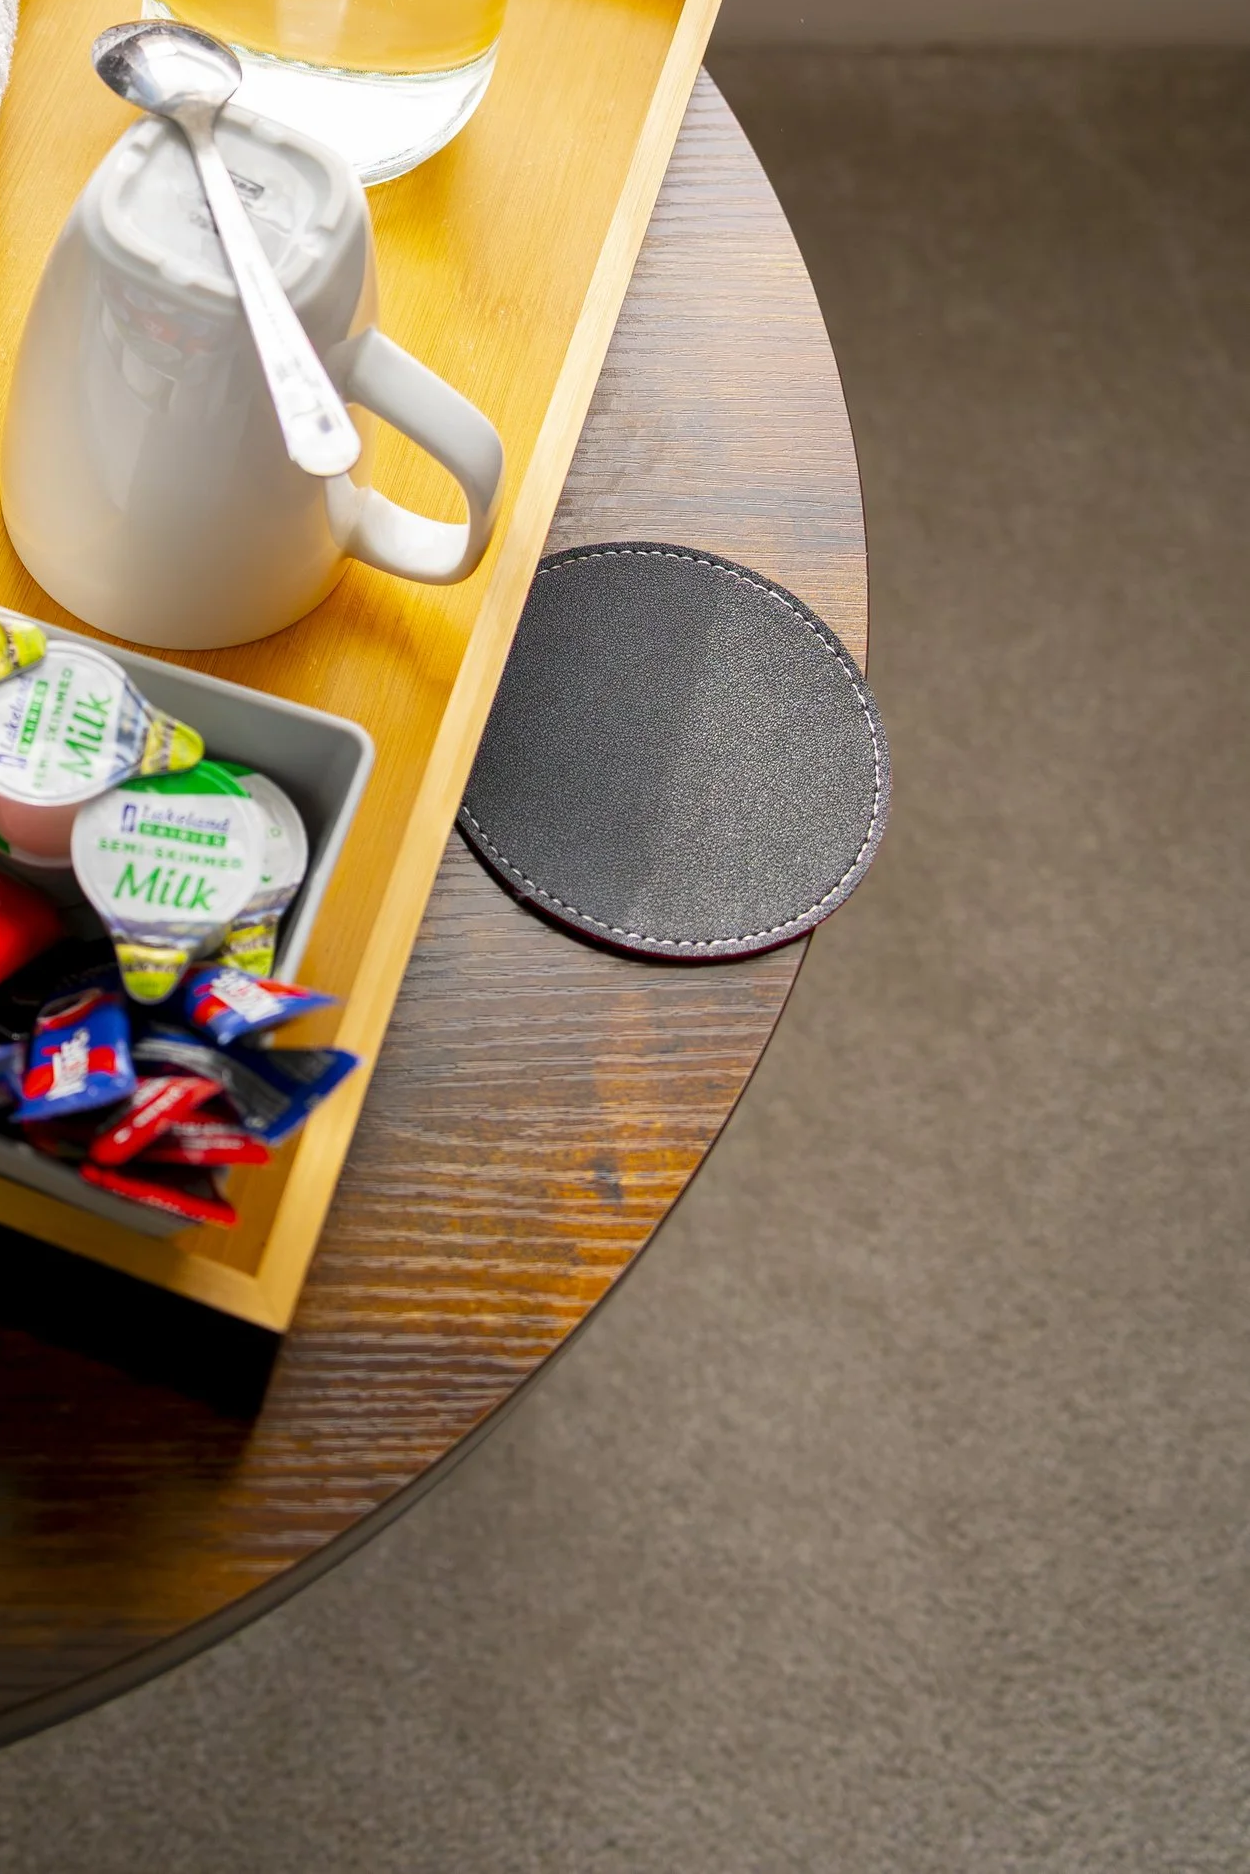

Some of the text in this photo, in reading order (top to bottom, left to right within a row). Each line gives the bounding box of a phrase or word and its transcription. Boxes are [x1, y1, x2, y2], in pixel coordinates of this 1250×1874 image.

[58, 692, 112, 779] Milk
[98, 837, 243, 869] SEMI-SKIMMED
[113, 861, 217, 912] Milk
